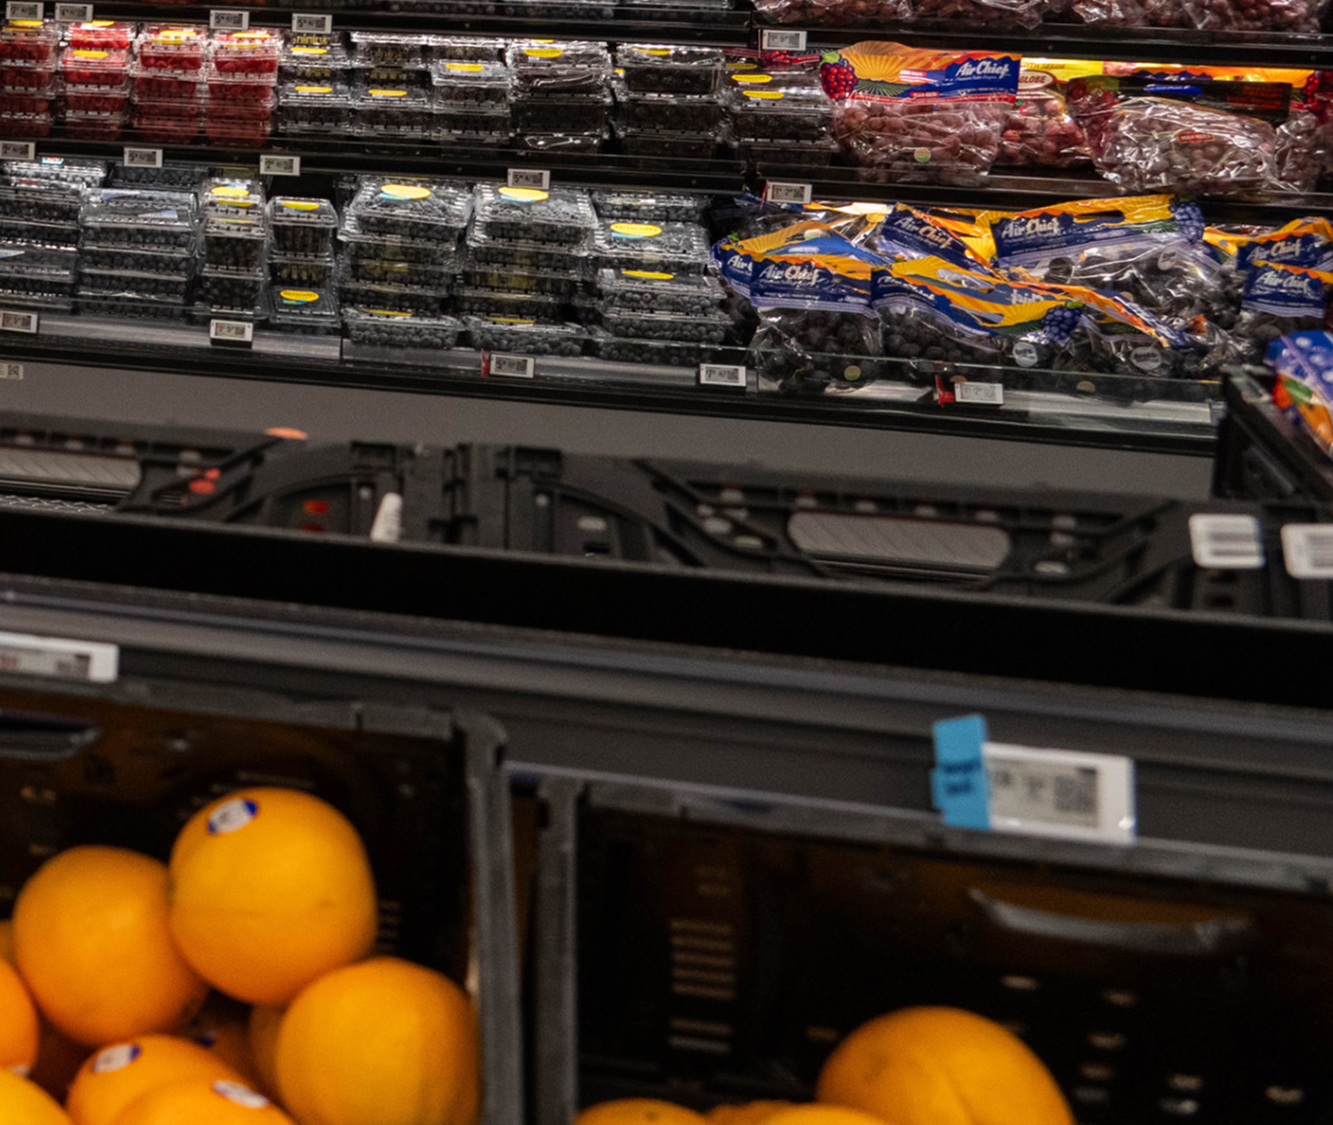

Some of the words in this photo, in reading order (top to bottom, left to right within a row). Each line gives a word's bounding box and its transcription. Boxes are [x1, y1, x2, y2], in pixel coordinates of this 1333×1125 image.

[956, 61, 976, 77] Air
[976, 60, 1009, 79] Chief
[1018, 74, 1046, 84] GLOBE
[894, 216, 919, 232] Air
[918, 226, 953, 249] Chief
[1001, 219, 1026, 239] Air
[1025, 216, 1060, 235] Chief
[1271, 238, 1302, 257] Chief
[727, 255, 748, 271] Air
[759, 264, 784, 280] Air
[784, 264, 820, 286] Chief
[1255, 272, 1281, 288] Air
[1282, 274, 1311, 290] Chief
